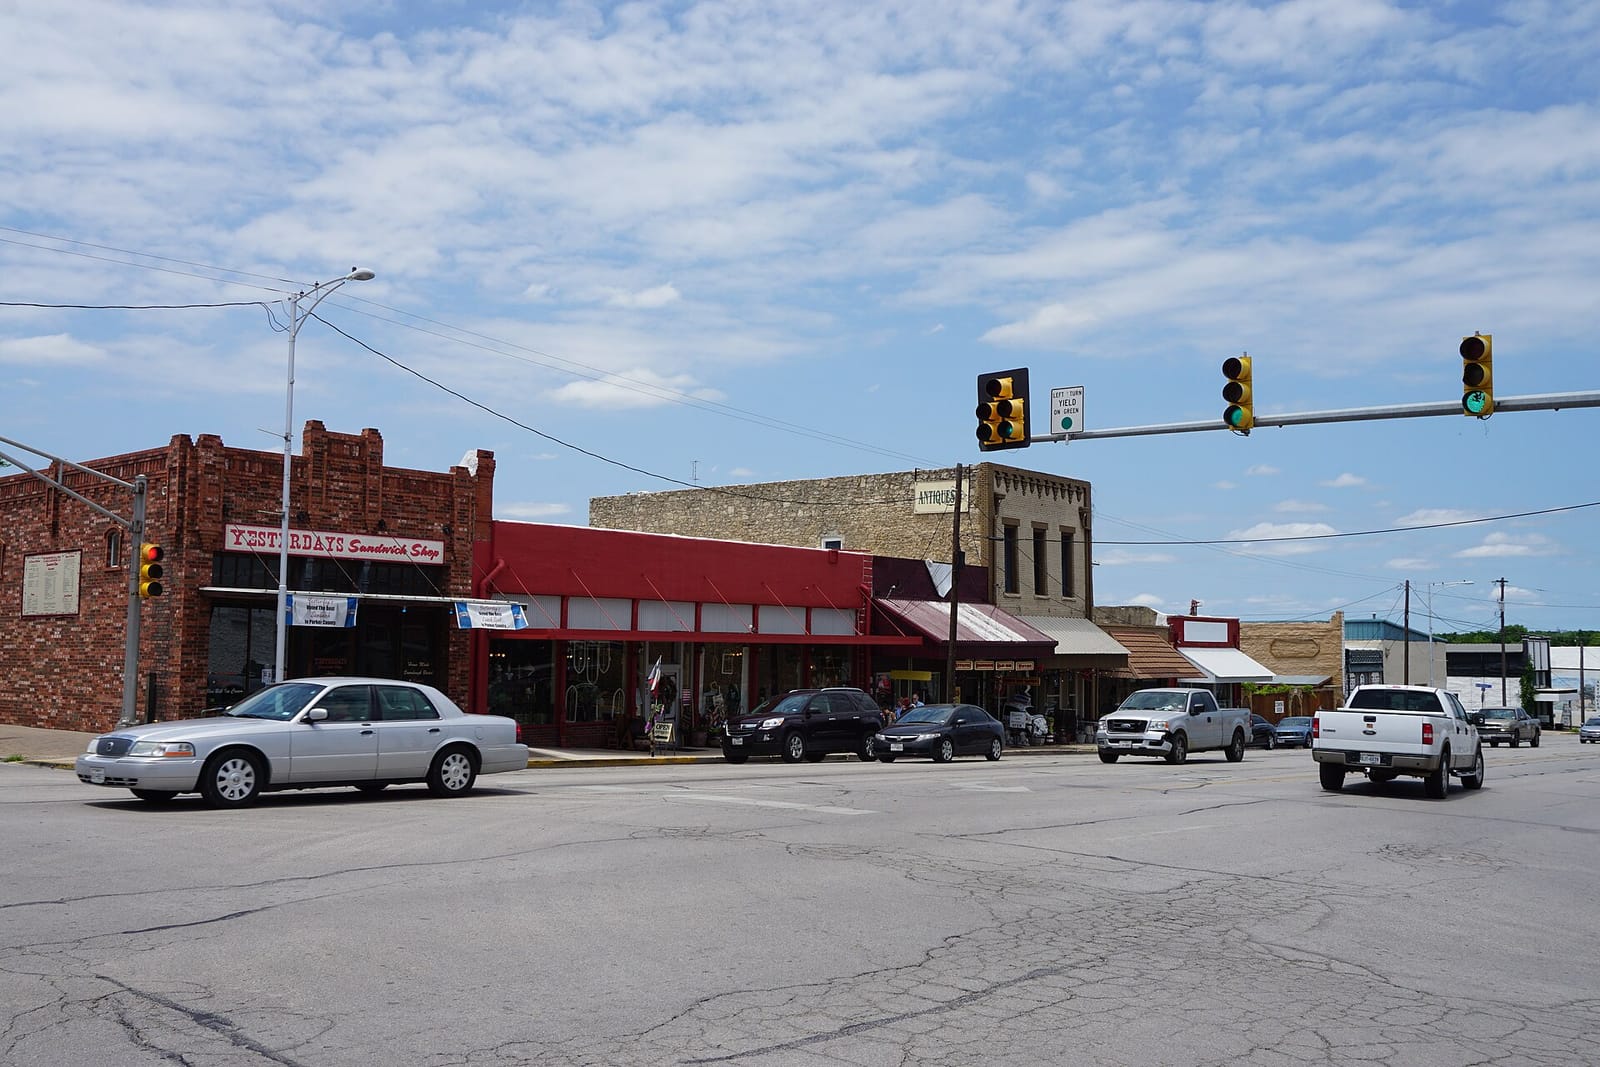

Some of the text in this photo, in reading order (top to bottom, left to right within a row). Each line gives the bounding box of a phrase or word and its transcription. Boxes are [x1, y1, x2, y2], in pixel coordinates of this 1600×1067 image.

[1059, 398, 1077, 407] YIELD
[918, 490, 955, 505] ANTIQUES
[230, 528, 440, 561] YESTRDAYS Sandwich Shop
